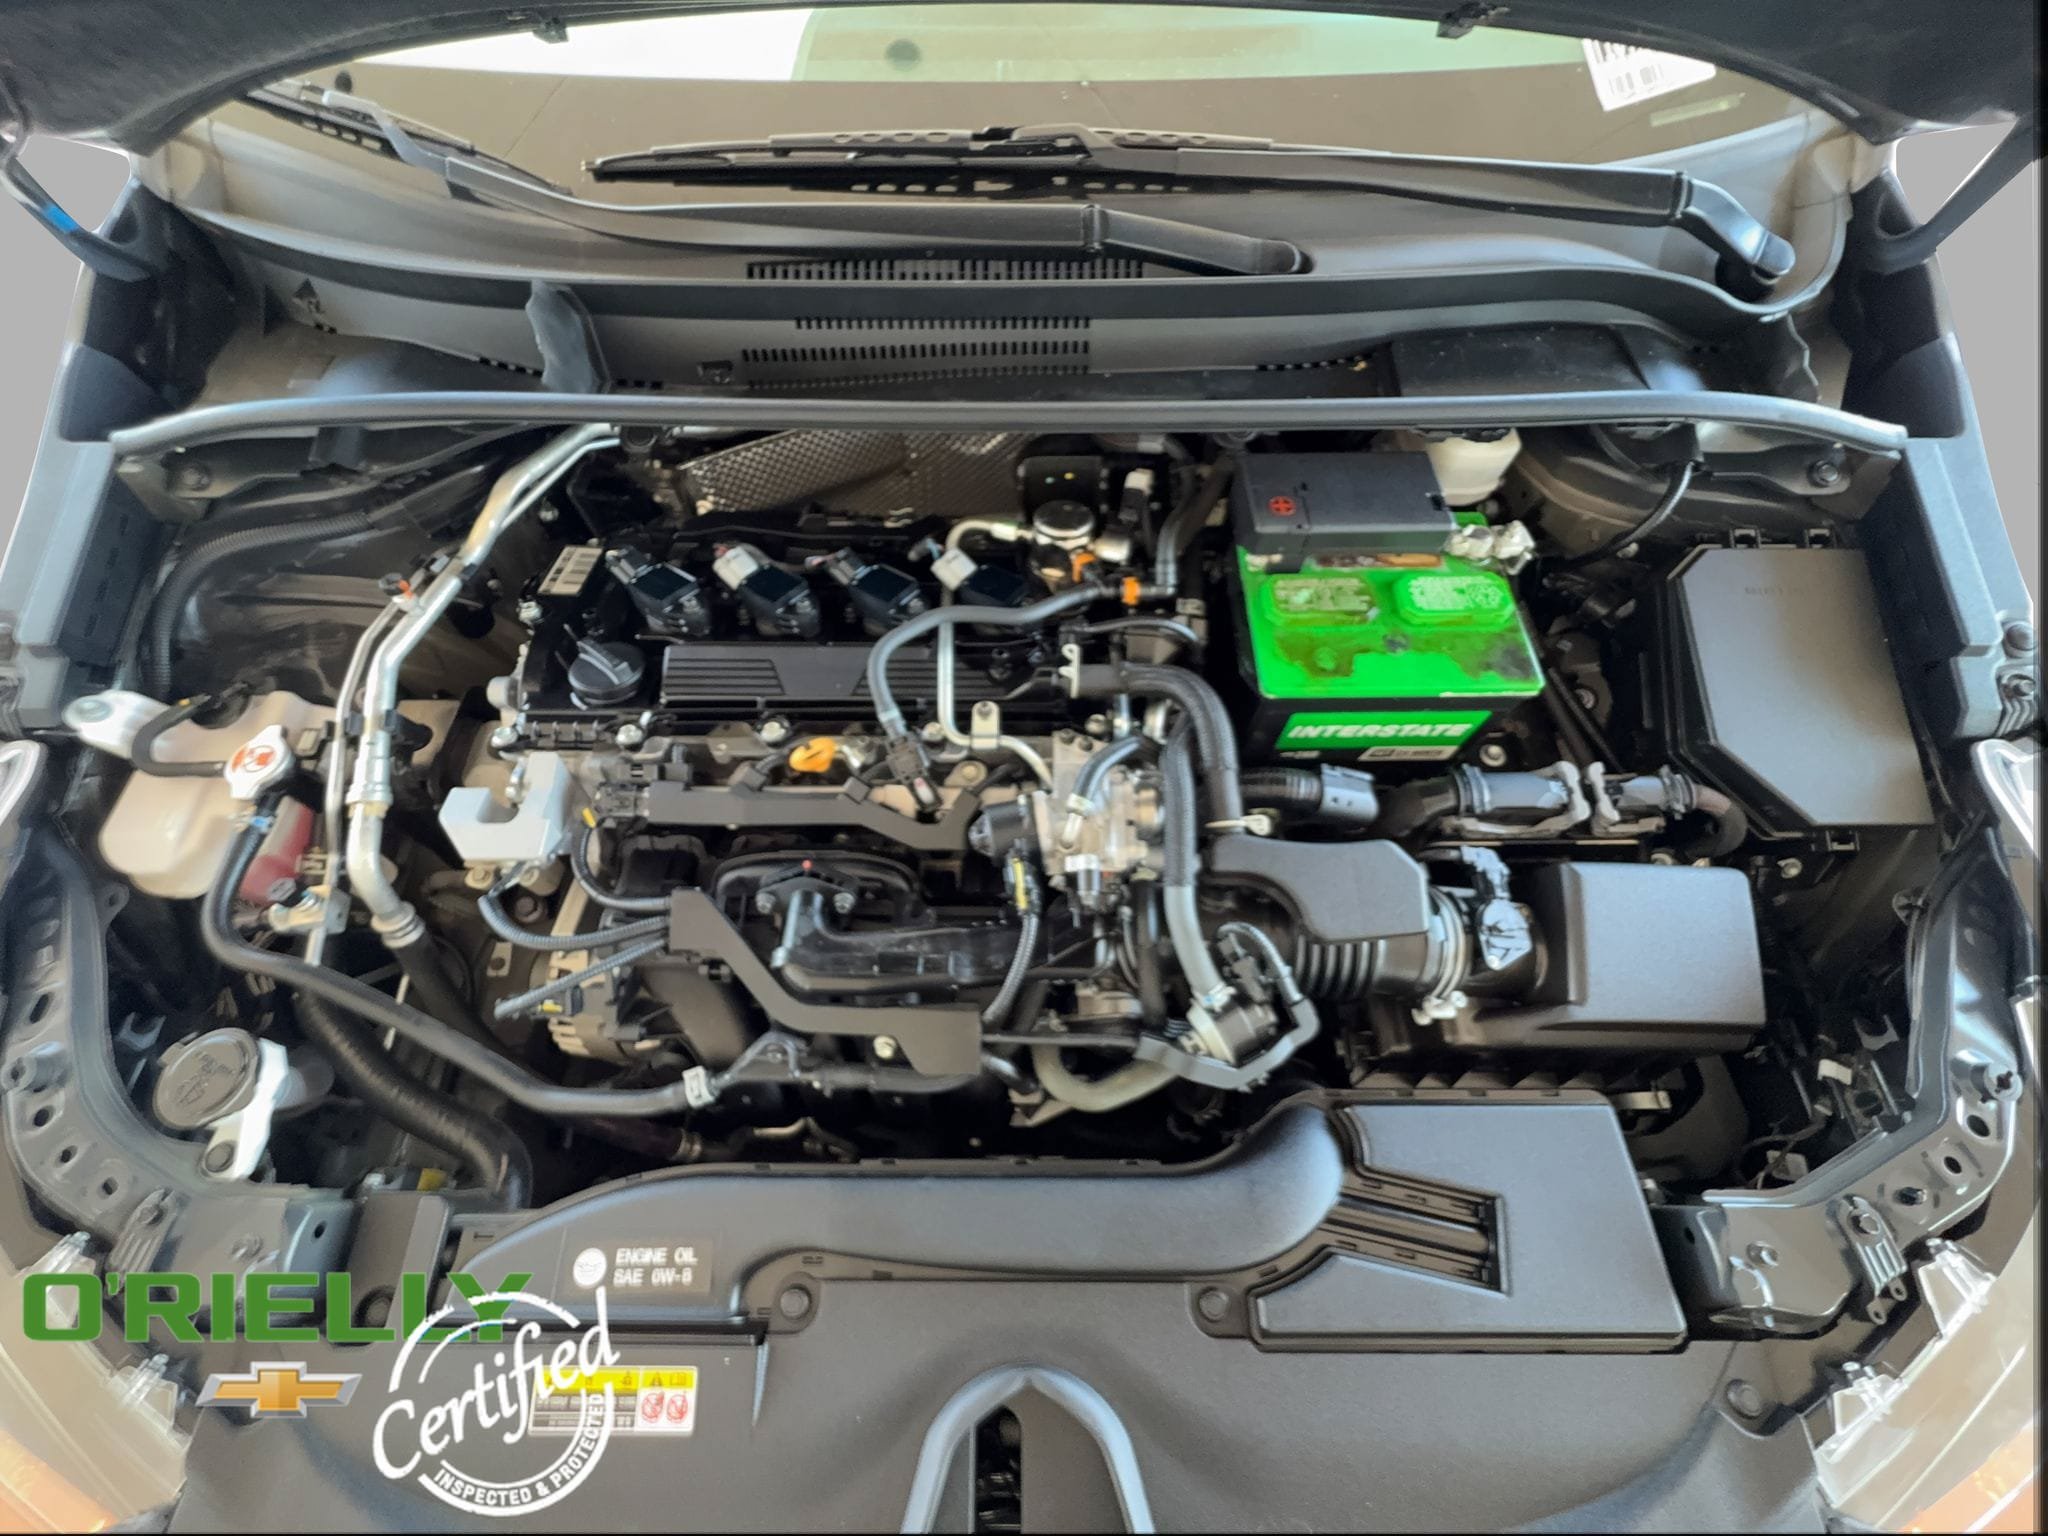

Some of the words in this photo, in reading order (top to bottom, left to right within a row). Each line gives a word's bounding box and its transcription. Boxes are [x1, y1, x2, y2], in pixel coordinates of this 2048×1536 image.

[1287, 724, 1472, 738] INTERSTATE
[615, 1248, 667, 1266] ENGINE
[674, 1247, 698, 1265] OIL
[613, 1268, 643, 1287] SAE
